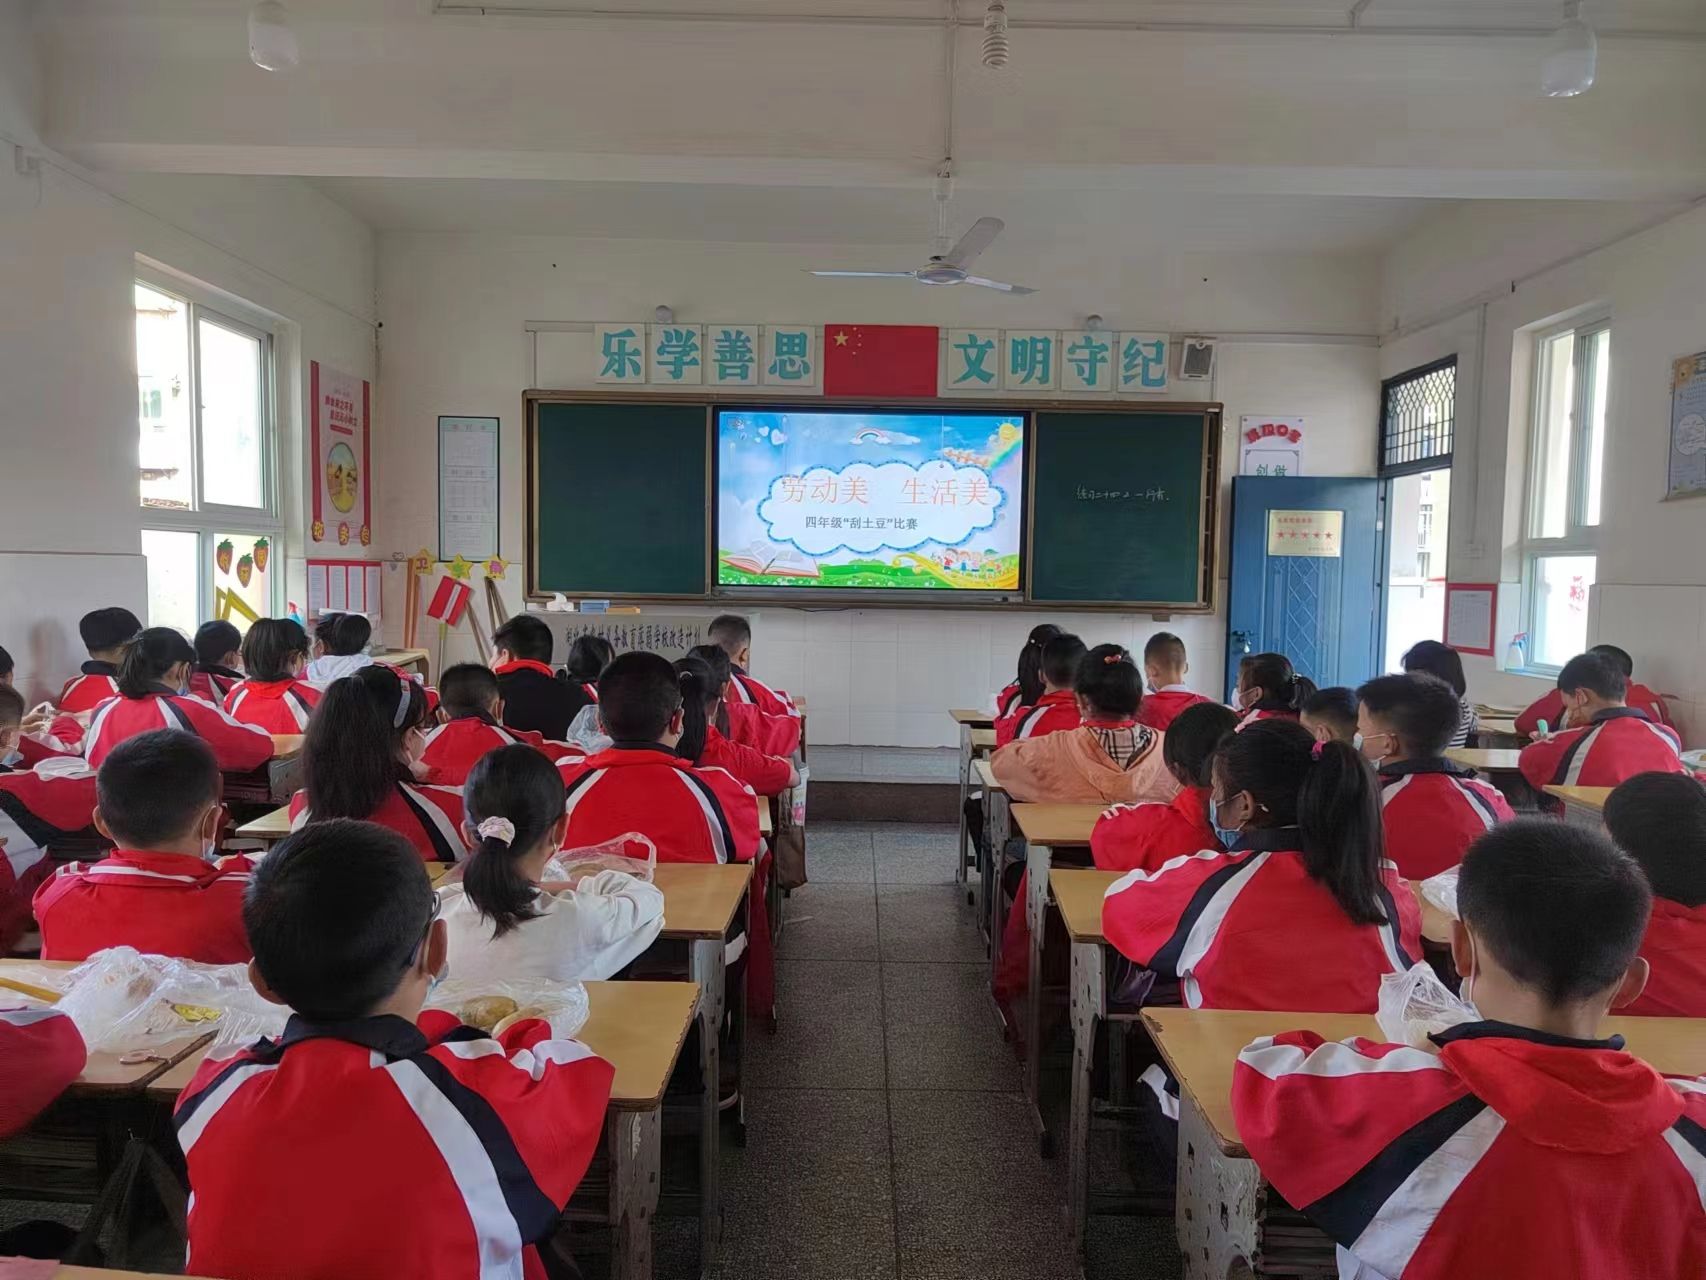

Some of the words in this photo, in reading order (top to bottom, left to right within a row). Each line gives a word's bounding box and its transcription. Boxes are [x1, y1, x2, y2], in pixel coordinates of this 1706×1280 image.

[600, 328, 811, 381] 乐学善思
[952, 333, 1167, 388] 文明守纪
[782, 475, 870, 505] 劳动美
[897, 476, 990, 507] 生活美
[804, 516, 919, 531] 四年级“刮土豆”比赛
